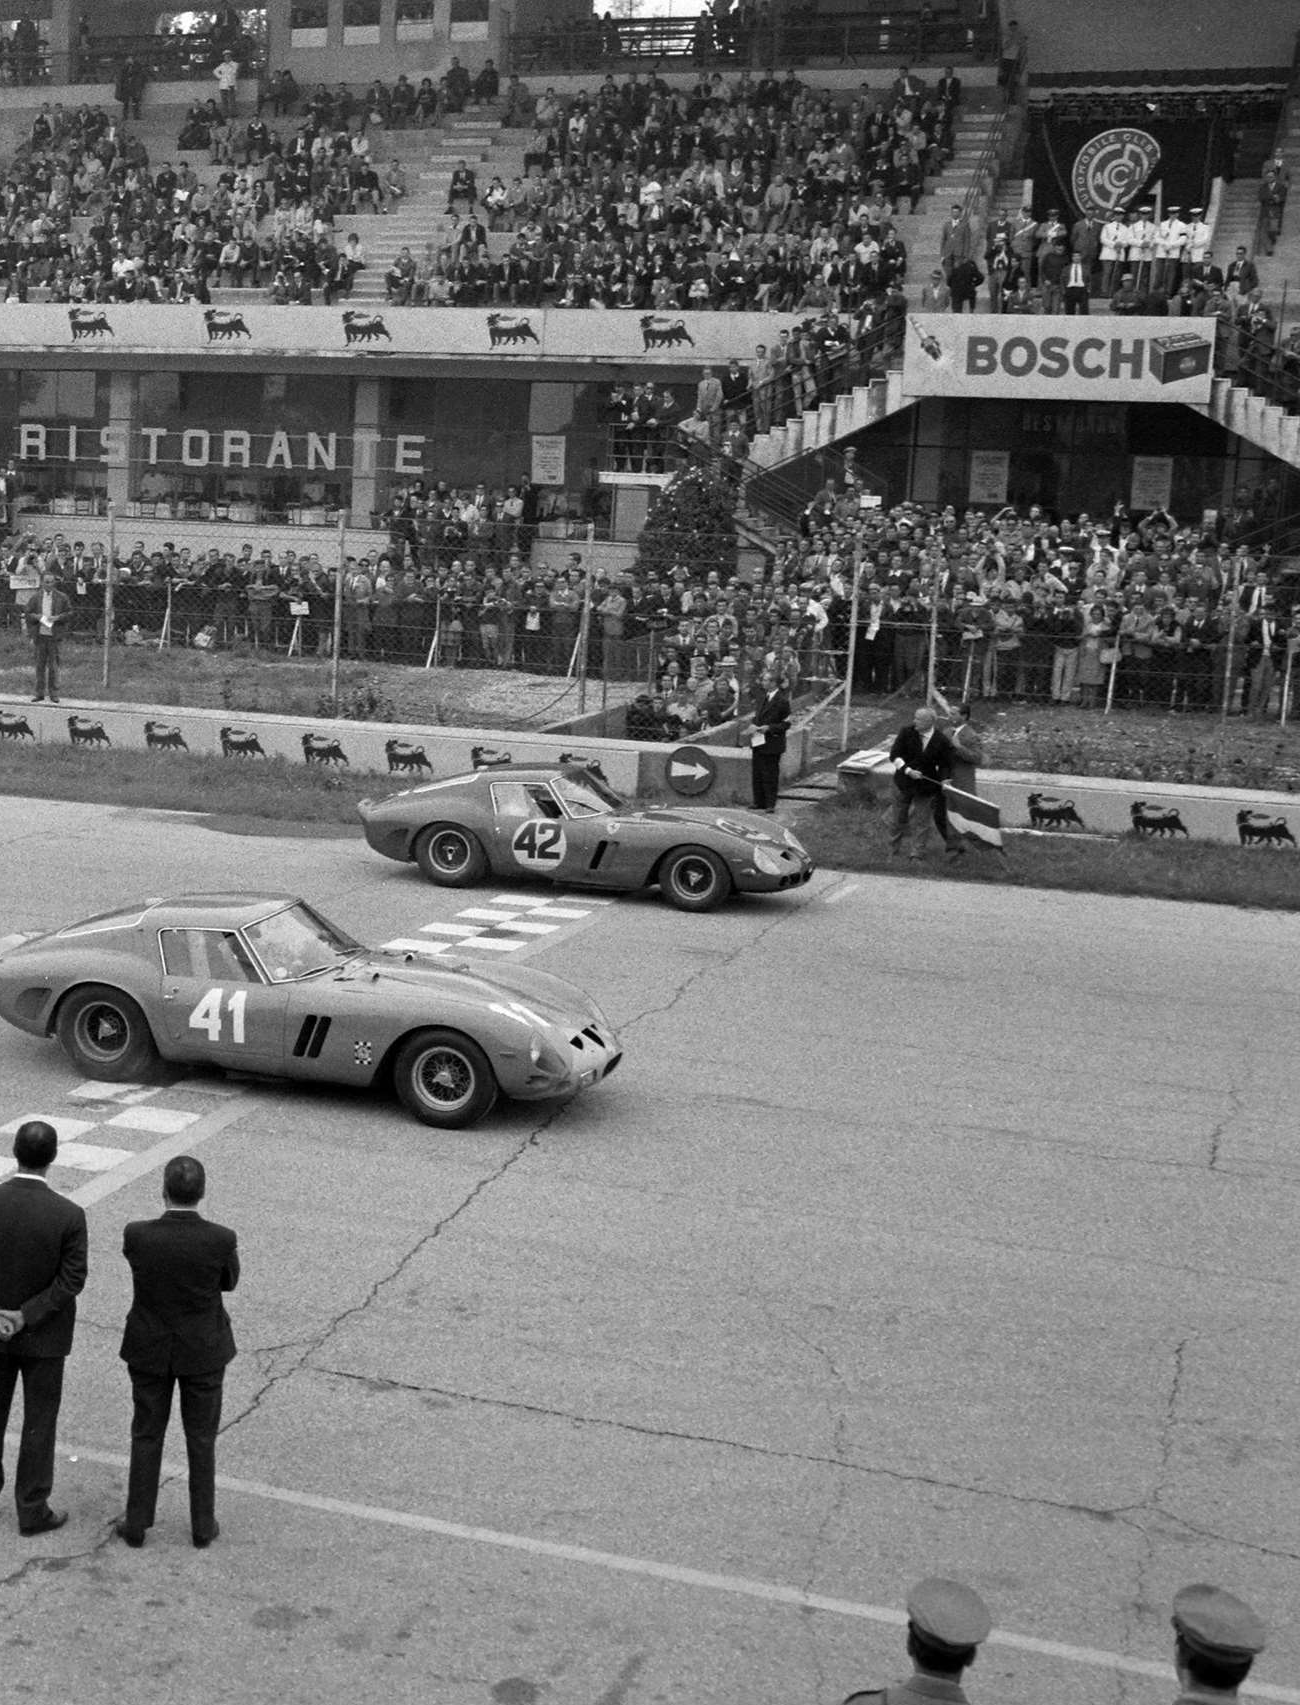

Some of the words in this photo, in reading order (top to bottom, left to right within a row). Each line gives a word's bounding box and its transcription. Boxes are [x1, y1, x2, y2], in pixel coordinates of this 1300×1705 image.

[1076, 133, 1117, 209] AUTOMOBILE
[1123, 132, 1155, 153] CLUB
[965, 335, 1145, 380] BOSCH
[19, 423, 428, 475] RISTORANTE
[513, 822, 562, 859] 42
[189, 987, 247, 1043] 41
